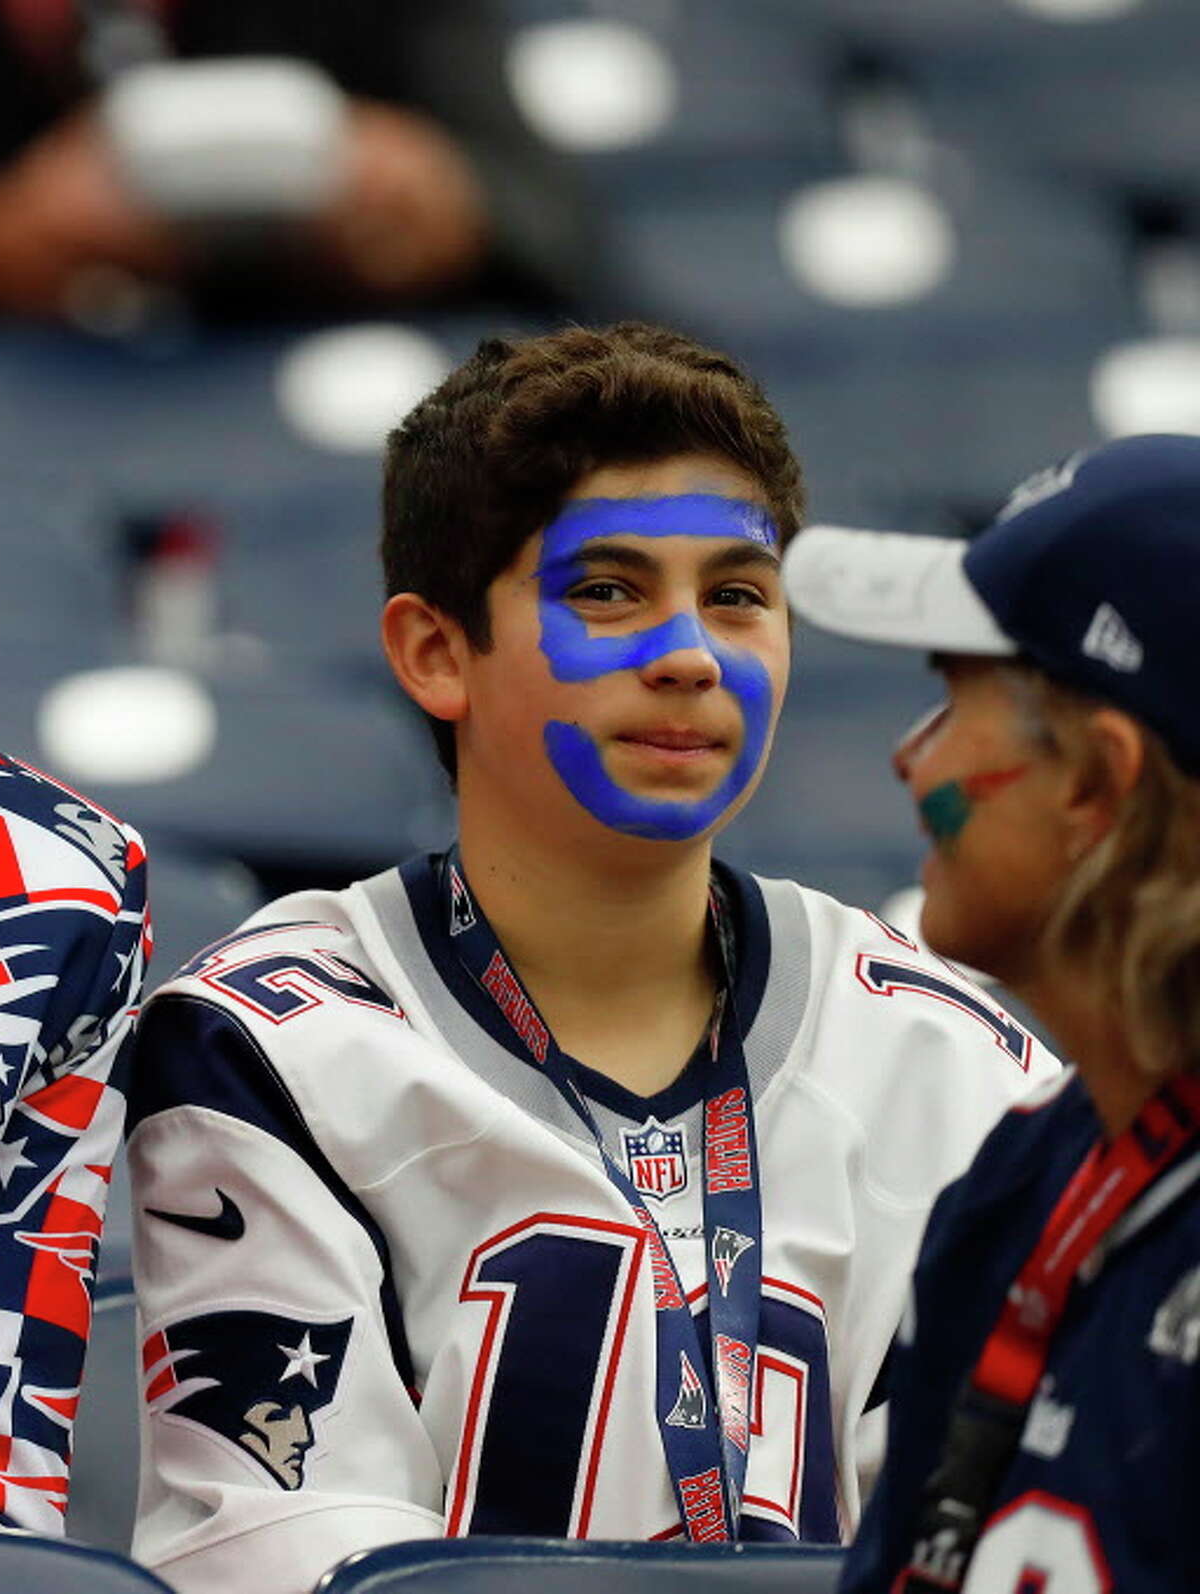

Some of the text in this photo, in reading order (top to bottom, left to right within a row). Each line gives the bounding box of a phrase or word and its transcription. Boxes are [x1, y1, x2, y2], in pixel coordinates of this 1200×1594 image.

[480, 949, 550, 1065] PATRIOTS
[633, 1156, 683, 1193] NFL
[704, 1086, 752, 1195] PATRIOTS
